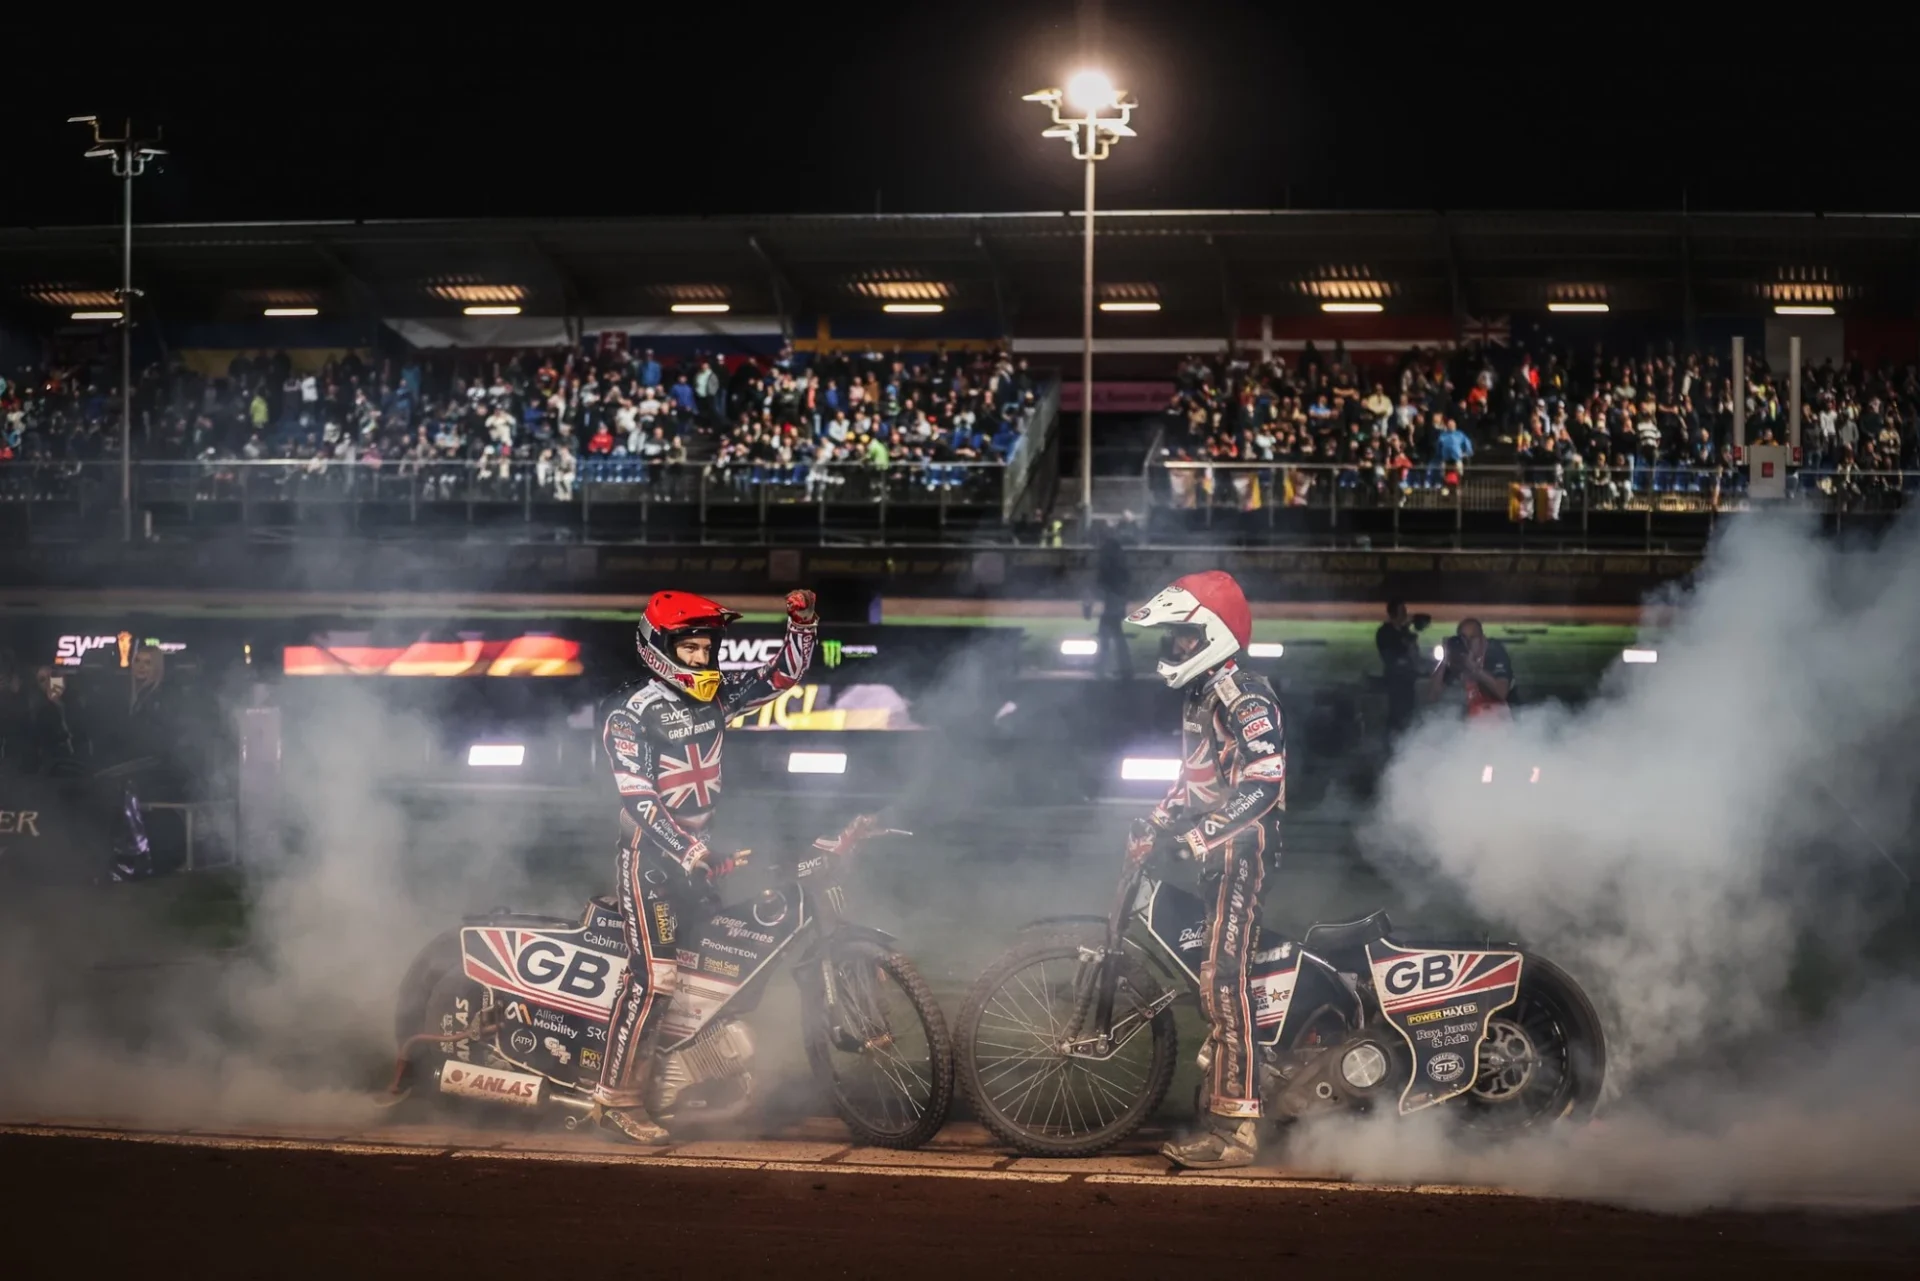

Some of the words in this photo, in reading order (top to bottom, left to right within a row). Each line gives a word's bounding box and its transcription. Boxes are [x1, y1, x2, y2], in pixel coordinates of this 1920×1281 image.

[660, 707, 690, 722] SWC
[668, 726, 693, 740] GREAT
[694, 719, 716, 735] BRITAIN
[1244, 719, 1269, 737] NGK
[1228, 788, 1265, 820] Mobility
[651, 822, 686, 852] Mobility
[621, 848, 633, 895] Roger
[798, 856, 822, 871] SWC
[656, 904, 667, 942] POWER
[711, 915, 748, 929] Roger
[727, 926, 775, 944] Warnes
[700, 938, 758, 959] PROMETEON
[517, 941, 611, 999] GB
[1385, 954, 1453, 995] GB
[535, 1008, 565, 1024] Allied
[1409, 1011, 1442, 1024] POWER
[1443, 1005, 1476, 1018] MAXED
[533, 1018, 578, 1039] Mobility
[1444, 1034, 1469, 1045] Ada
[1434, 1061, 1457, 1073] STS
[469, 1074, 538, 1098] ANLAS
